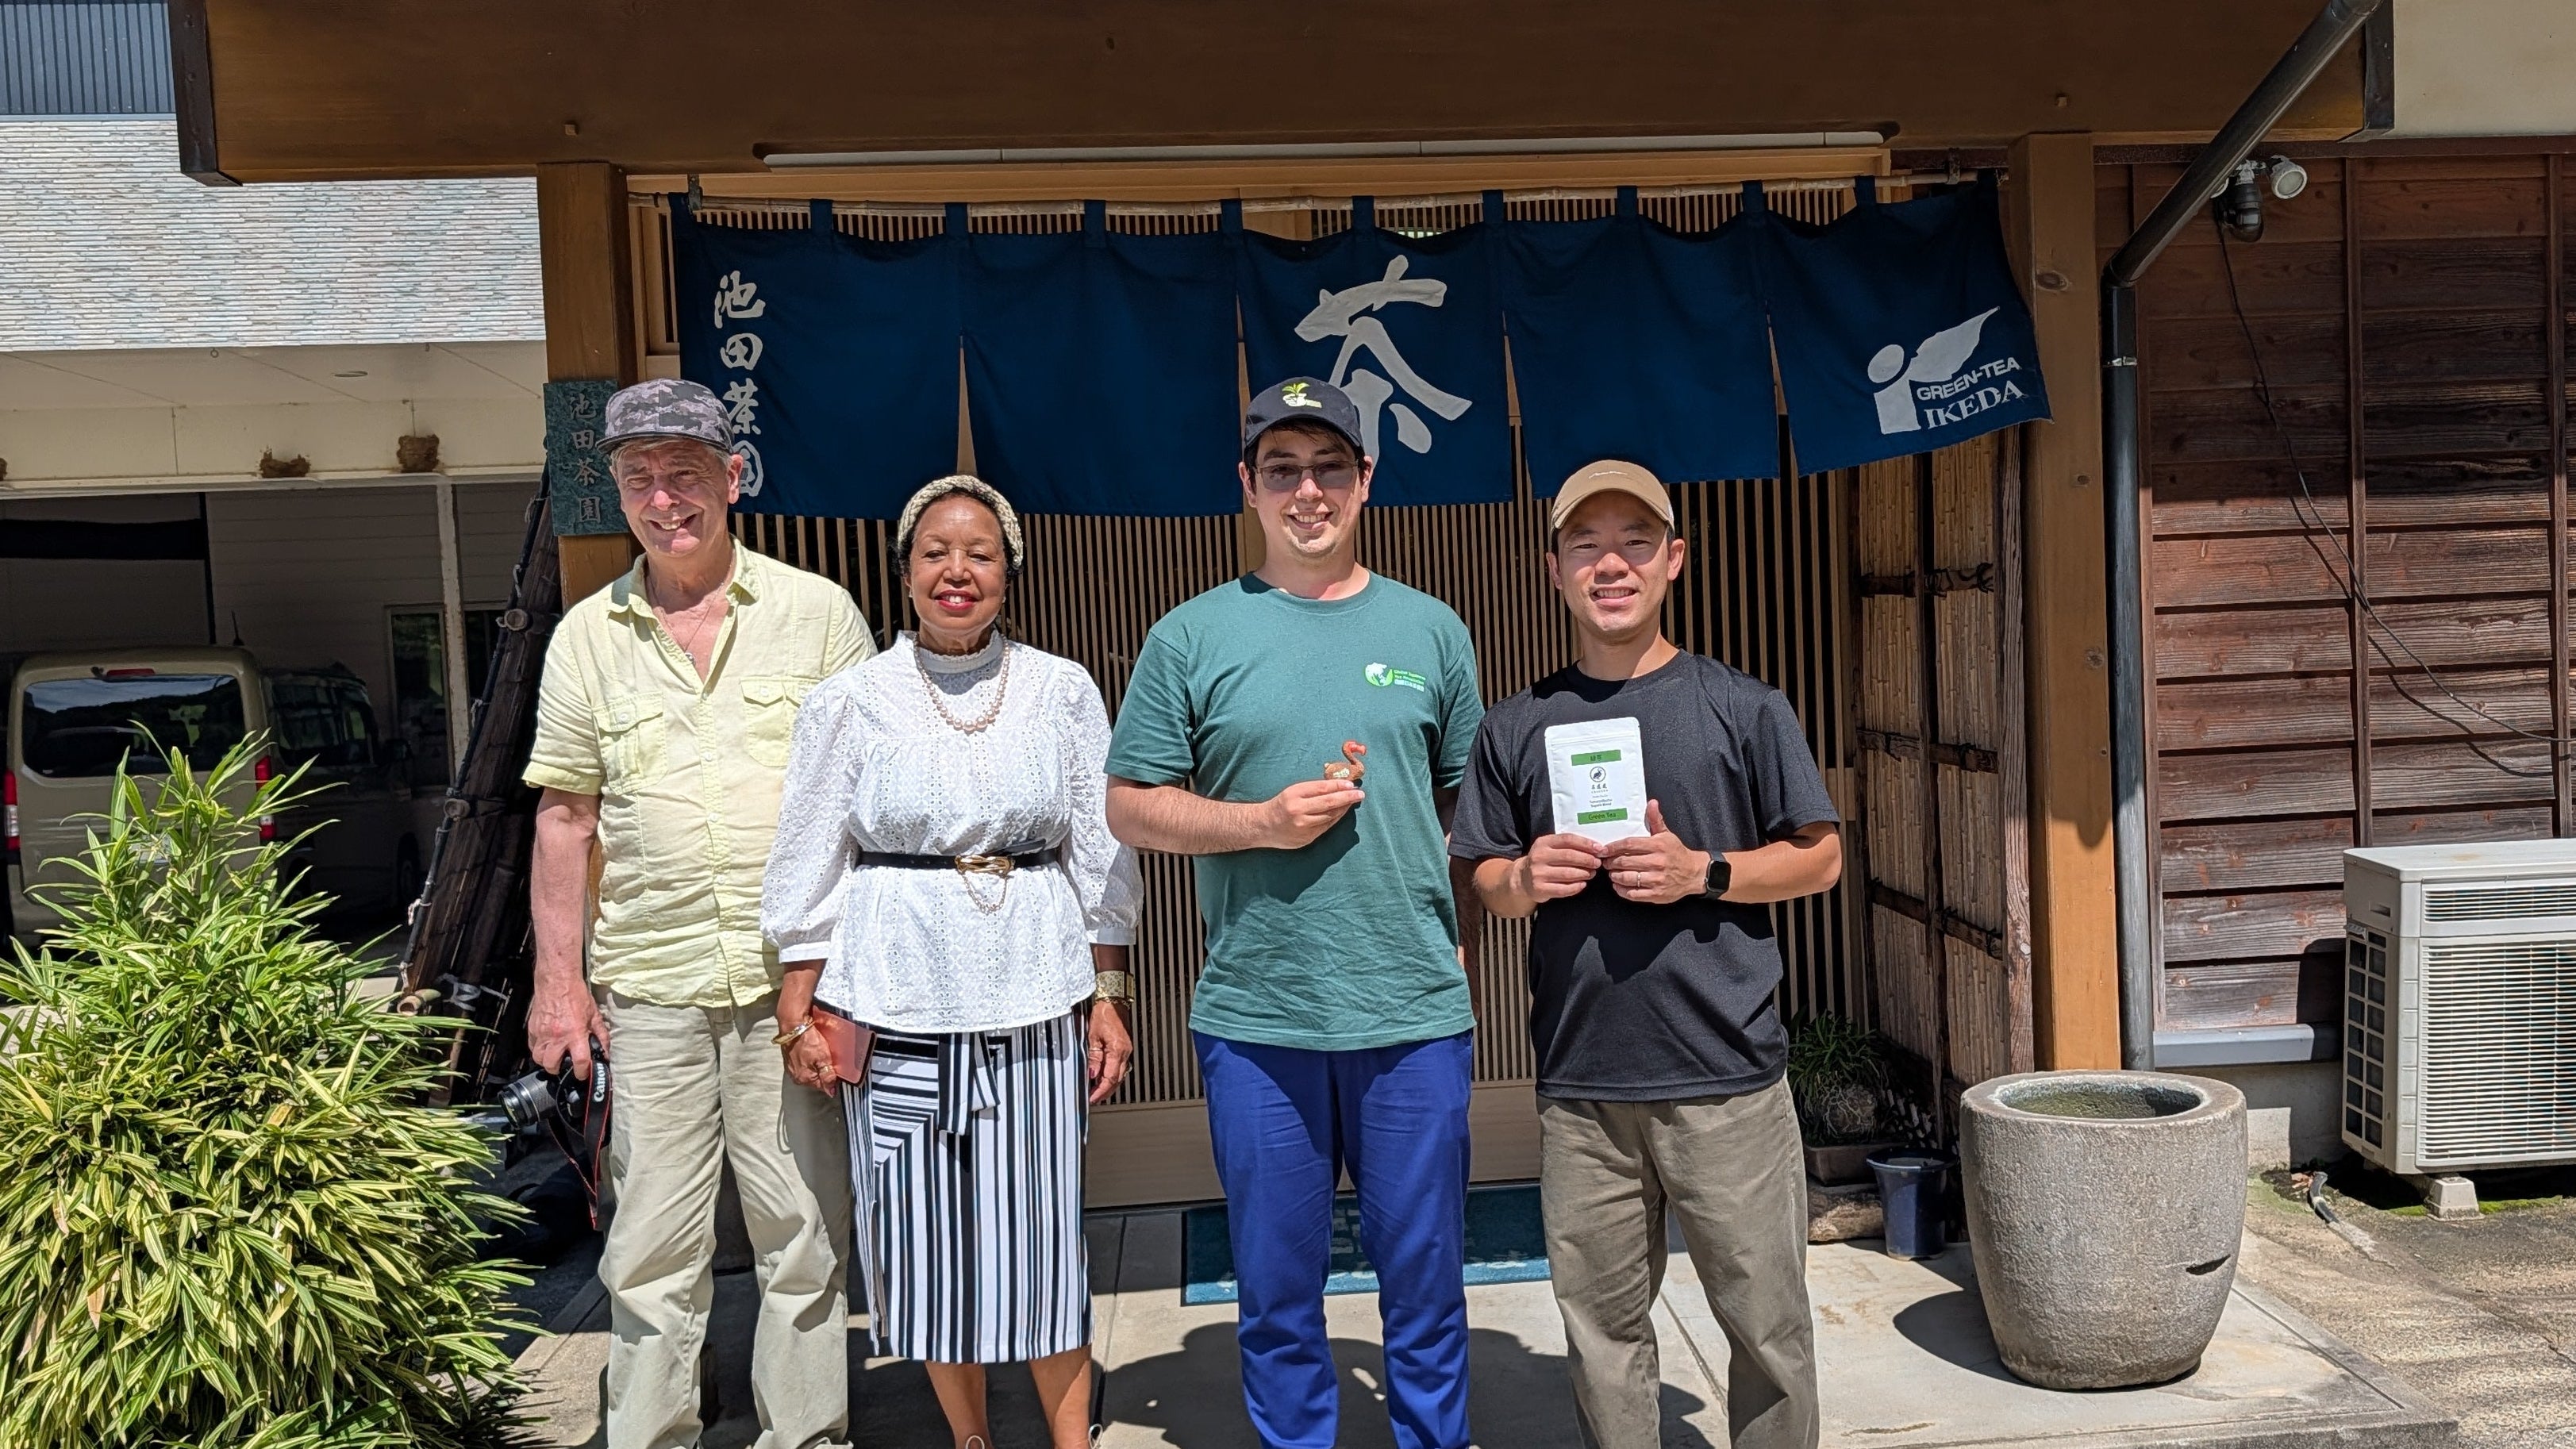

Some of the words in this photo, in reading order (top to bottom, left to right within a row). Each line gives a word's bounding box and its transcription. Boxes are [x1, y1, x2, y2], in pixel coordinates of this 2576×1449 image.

[1917, 357, 2022, 401] GREEN-TEA
[1924, 380, 2024, 429] IKEDA
[570, 393, 602, 524] 池田茶園
[594, 1063, 606, 1102] Canon
